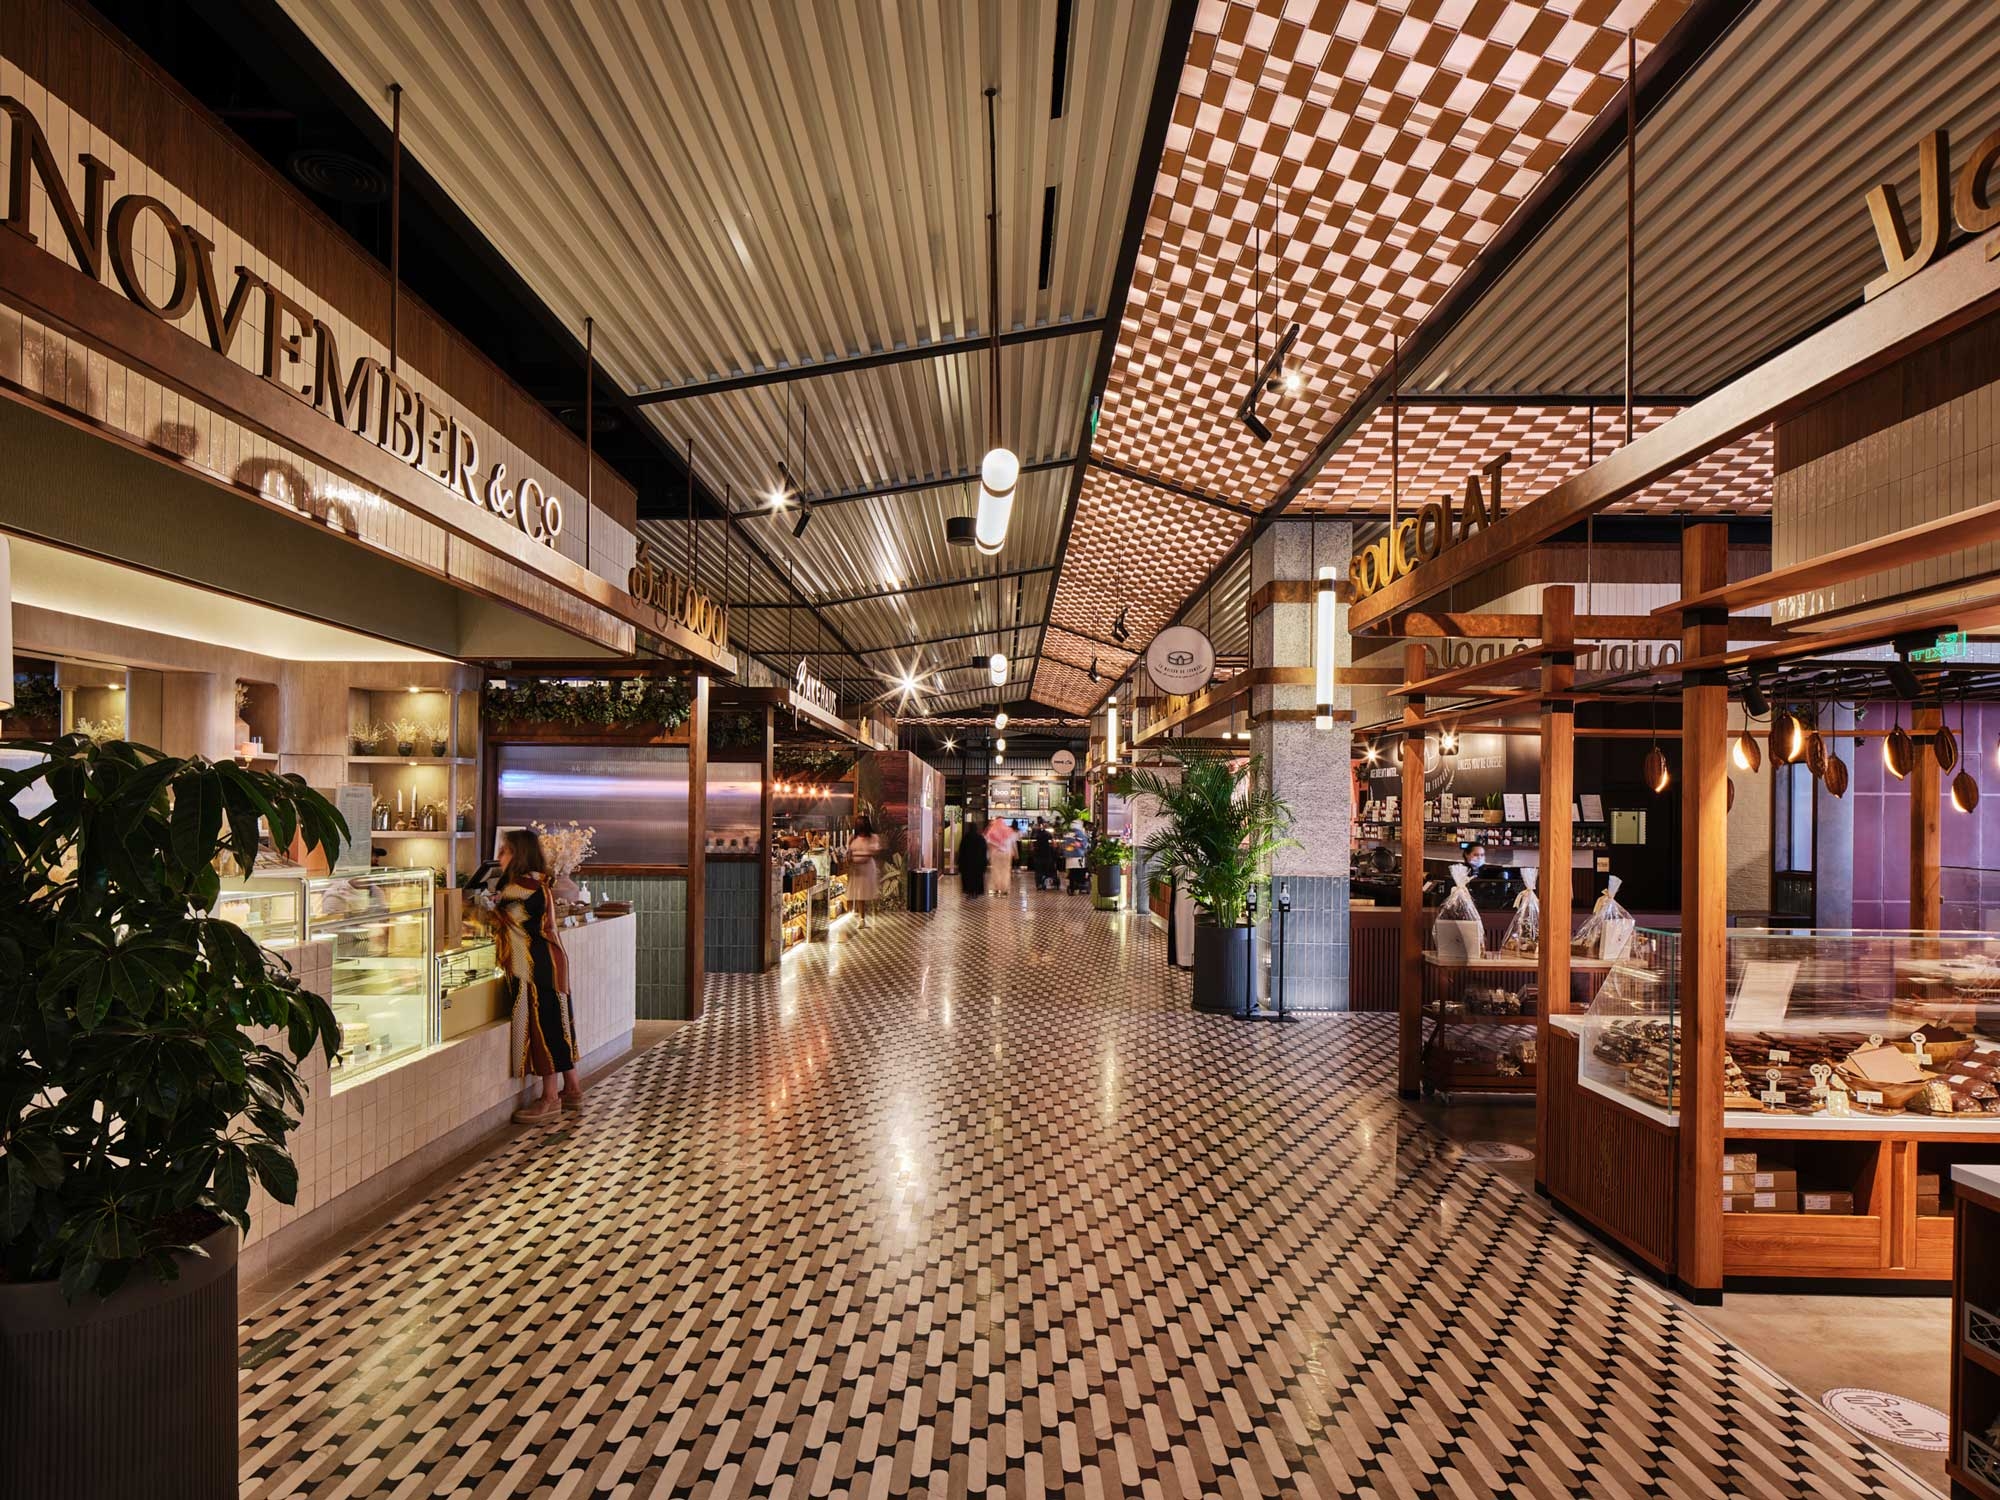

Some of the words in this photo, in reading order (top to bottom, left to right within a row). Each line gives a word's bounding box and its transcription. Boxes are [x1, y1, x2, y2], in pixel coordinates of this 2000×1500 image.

[0, 95, 484, 506] NOVEMBER
[485, 463, 516, 519] &
[1349, 452, 1512, 606] SOUCOLAT
